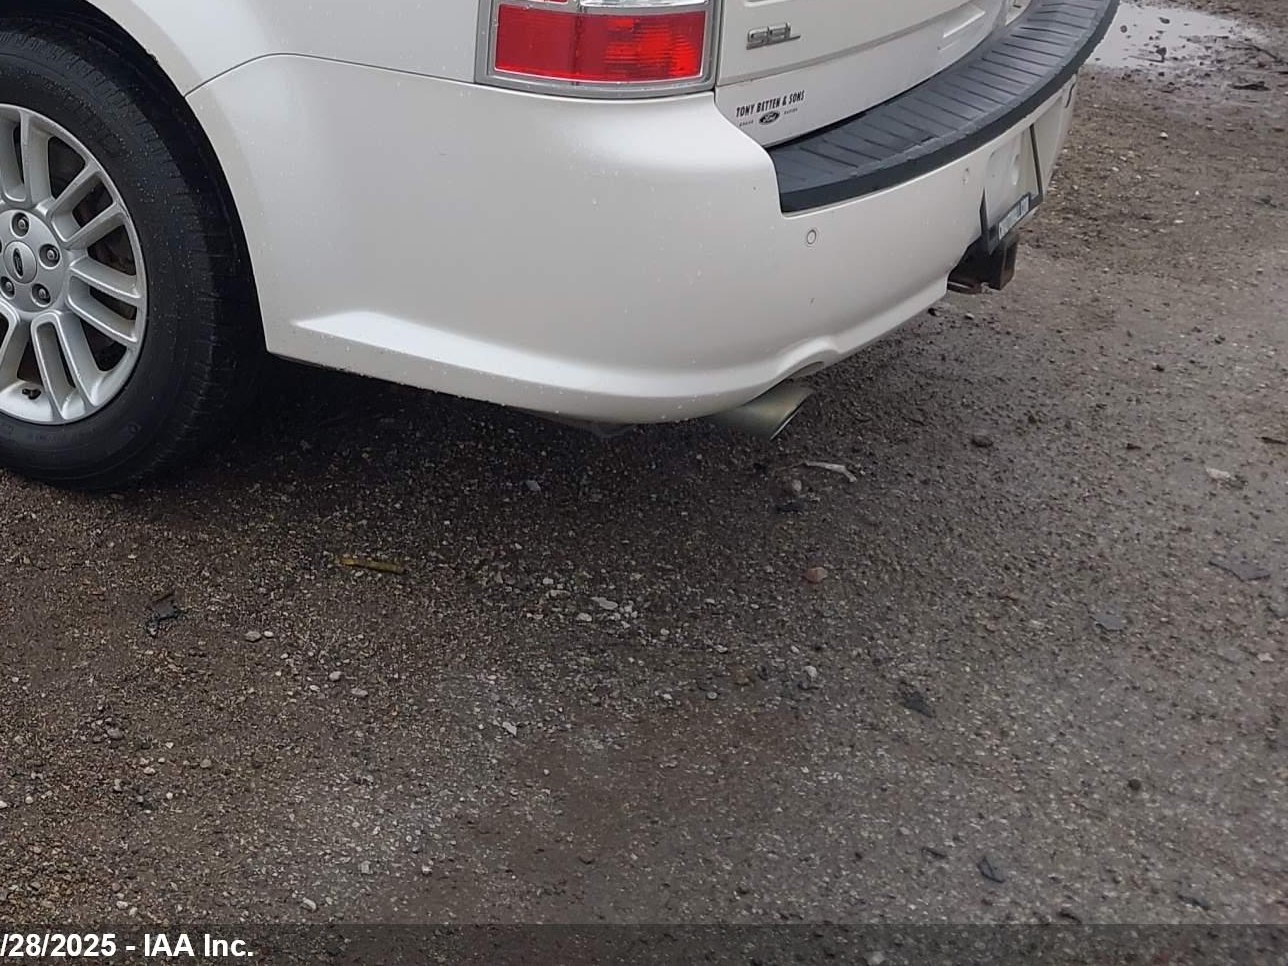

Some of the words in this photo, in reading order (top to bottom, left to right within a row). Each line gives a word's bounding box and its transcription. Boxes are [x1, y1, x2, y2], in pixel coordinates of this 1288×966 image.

[736, 103, 755, 118] TONY
[756, 98, 781, 113] BETTEN
[782, 95, 787, 106] &
[788, 89, 805, 105] SONS
